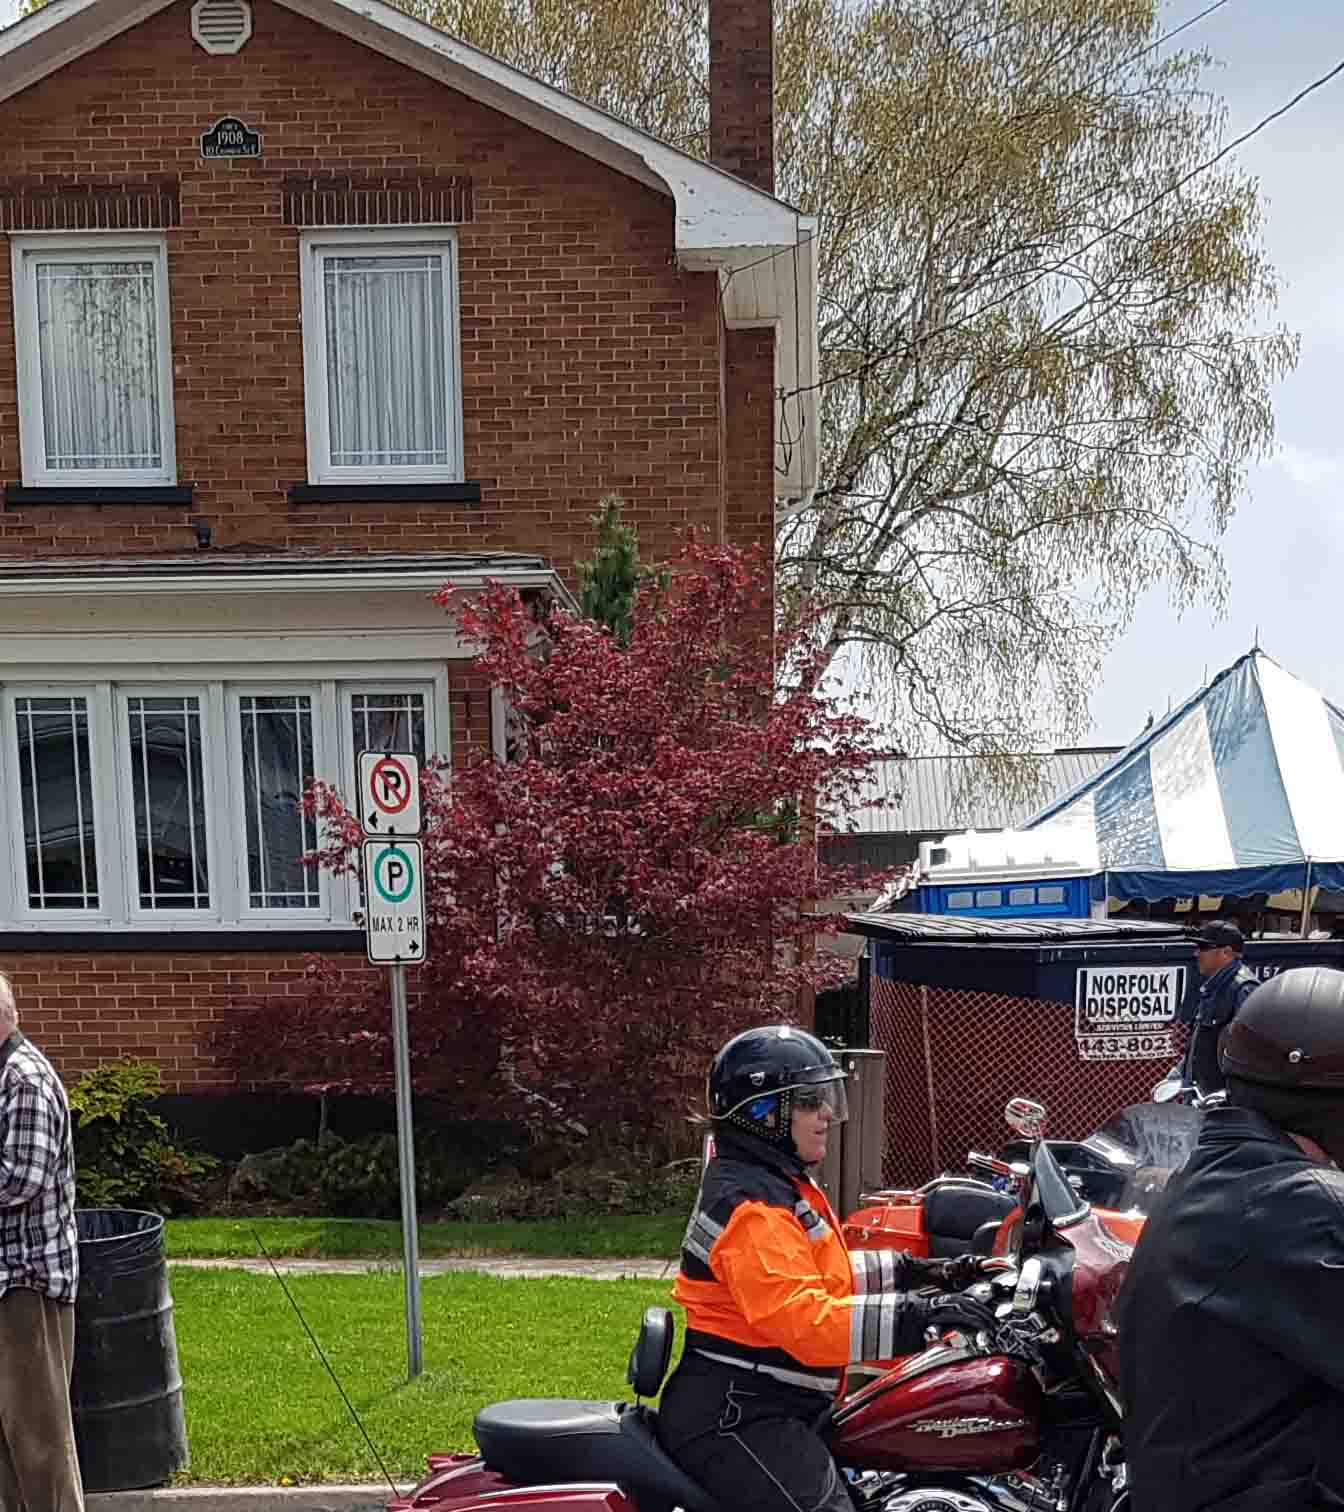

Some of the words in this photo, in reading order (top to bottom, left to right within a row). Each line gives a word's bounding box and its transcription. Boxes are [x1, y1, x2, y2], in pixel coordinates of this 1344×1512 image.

[217, 131, 244, 145] 1908
[387, 861, 403, 892] P
[372, 916, 393, 931] MAX
[397, 916, 404, 931] 2
[407, 915, 419, 930] HR
[1091, 974, 1170, 995] NORFOLK
[1087, 996, 1173, 1018] DISPOSAL
